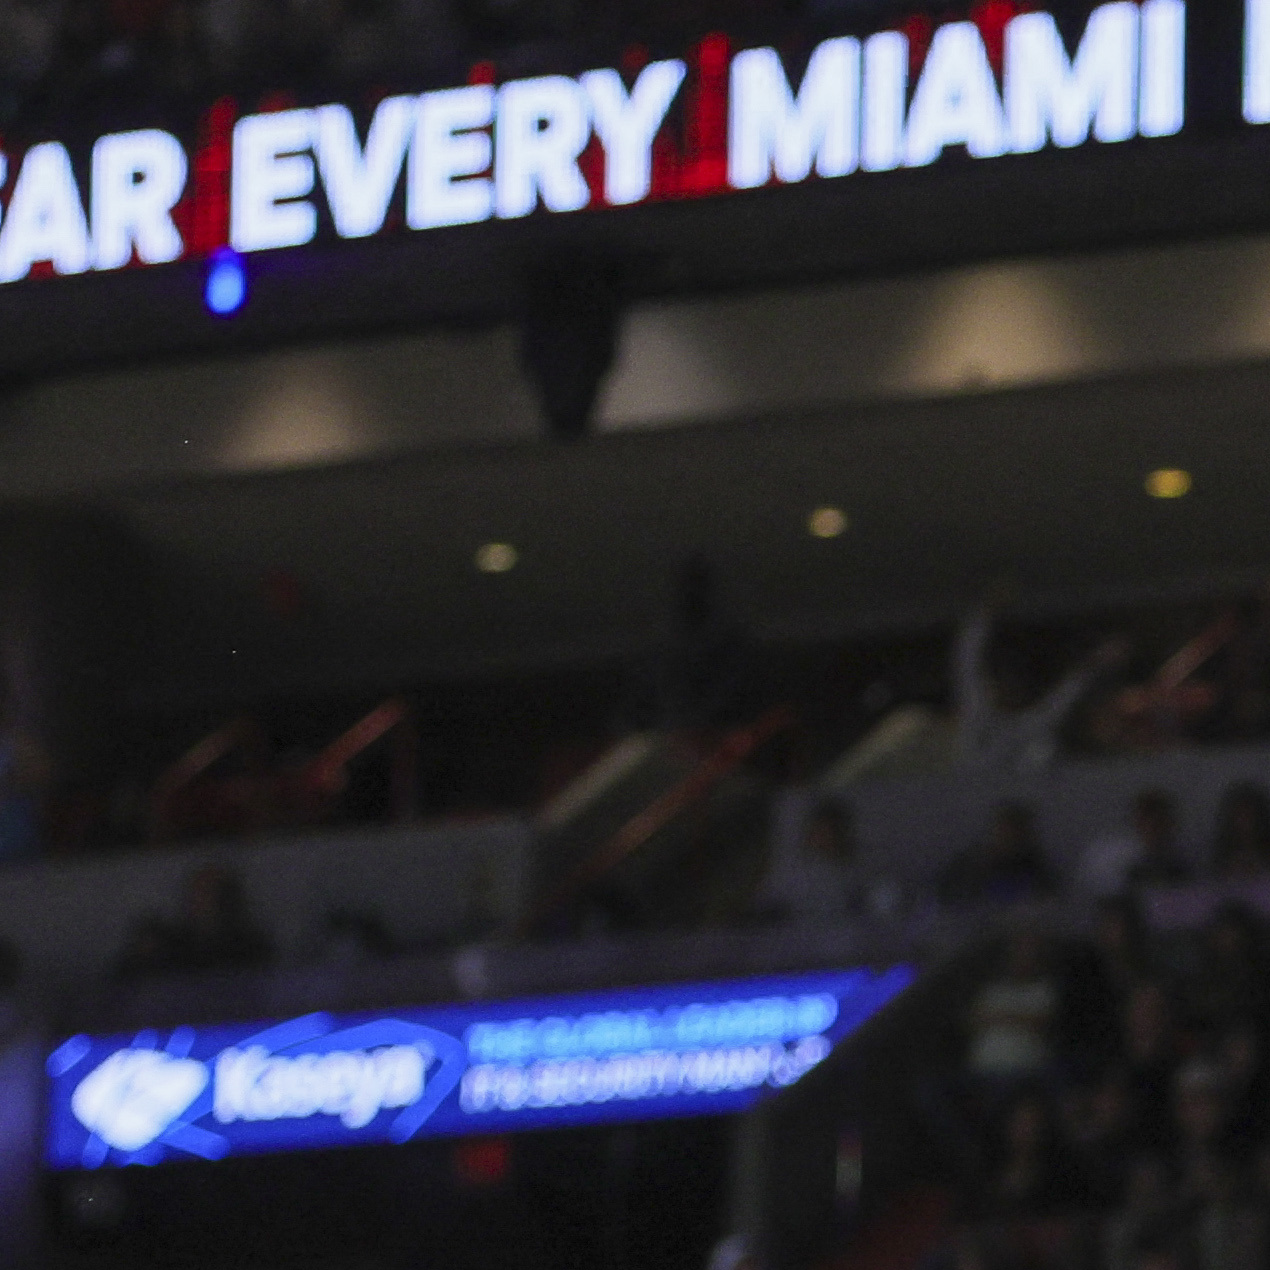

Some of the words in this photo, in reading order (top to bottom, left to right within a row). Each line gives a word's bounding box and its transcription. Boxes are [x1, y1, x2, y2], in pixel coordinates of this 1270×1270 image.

[0, 127, 188, 284] AR
[230, 59, 687, 253] EVERY
[728, 0, 1185, 190] MIAMI
